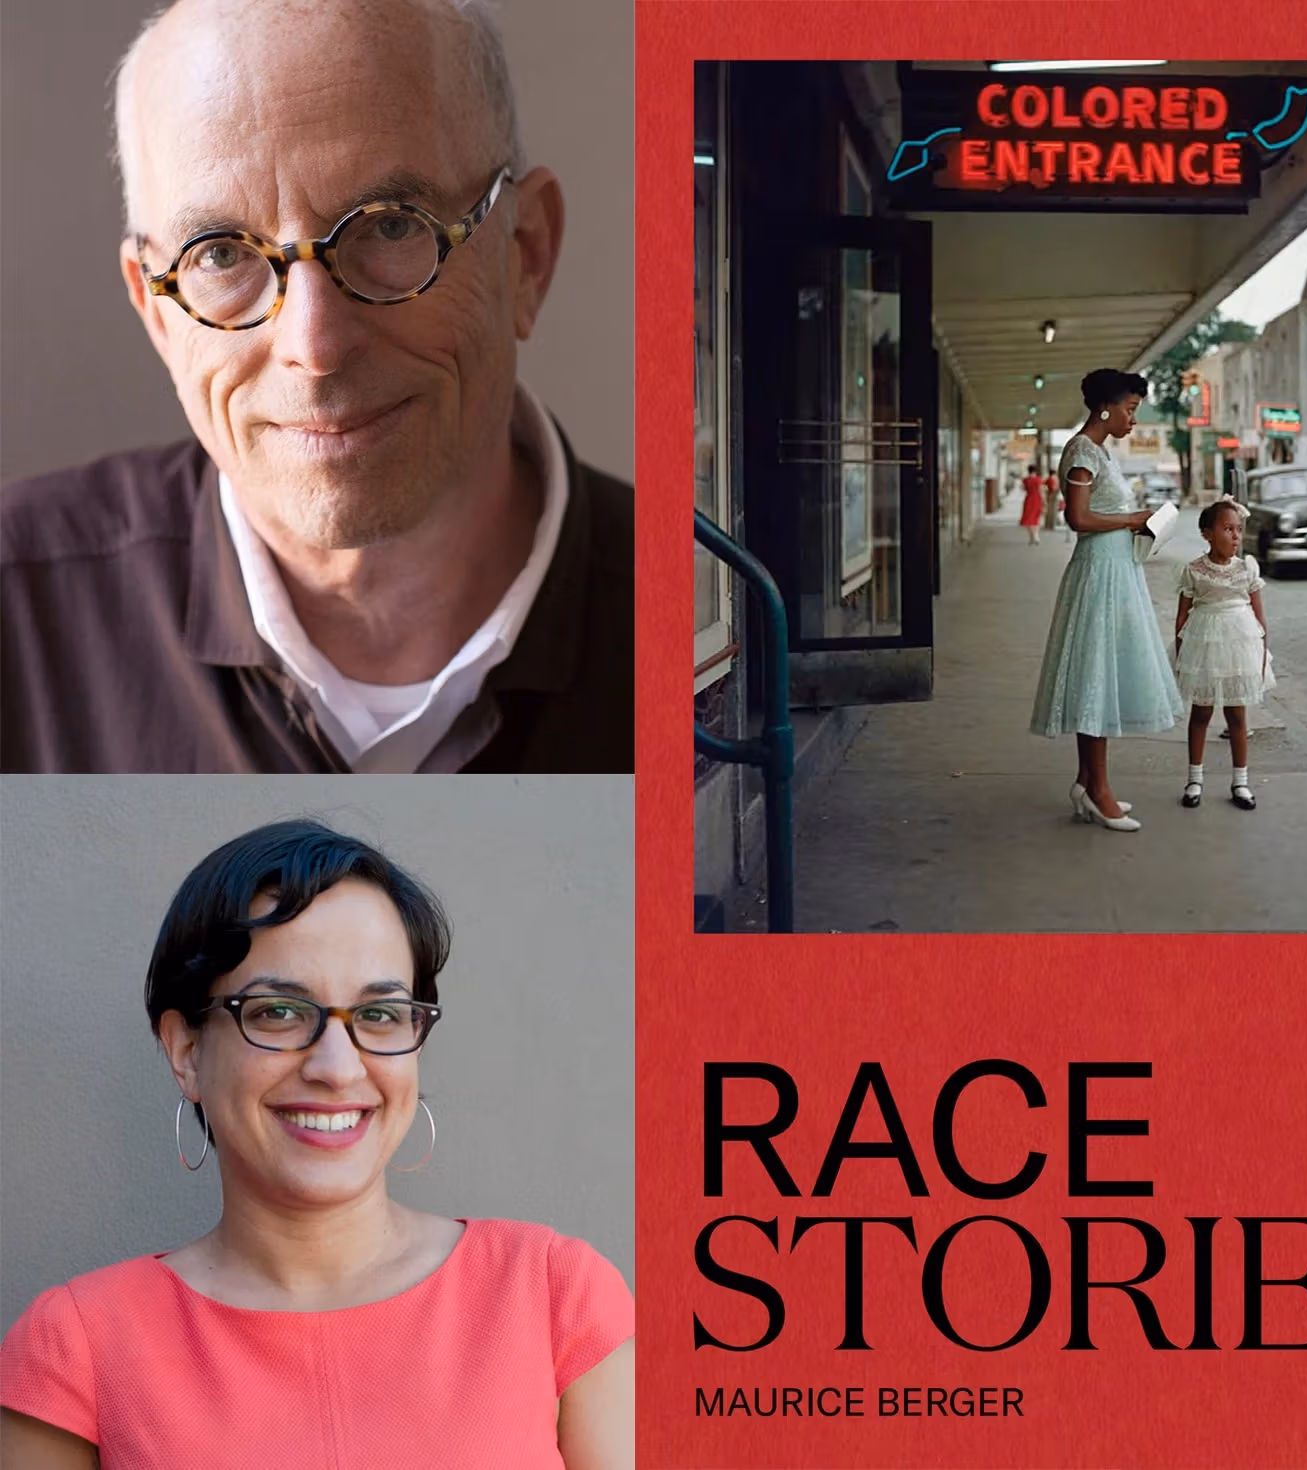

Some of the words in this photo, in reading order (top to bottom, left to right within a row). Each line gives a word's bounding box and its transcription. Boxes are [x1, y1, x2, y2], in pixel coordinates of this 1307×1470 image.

[977, 83, 1229, 131] COLORED
[959, 139, 1242, 185] ENTRANCE
[703, 1058, 1154, 1201] RACE
[695, 1387, 865, 1417] MAURICE
[878, 1387, 1024, 1417] BERGER
